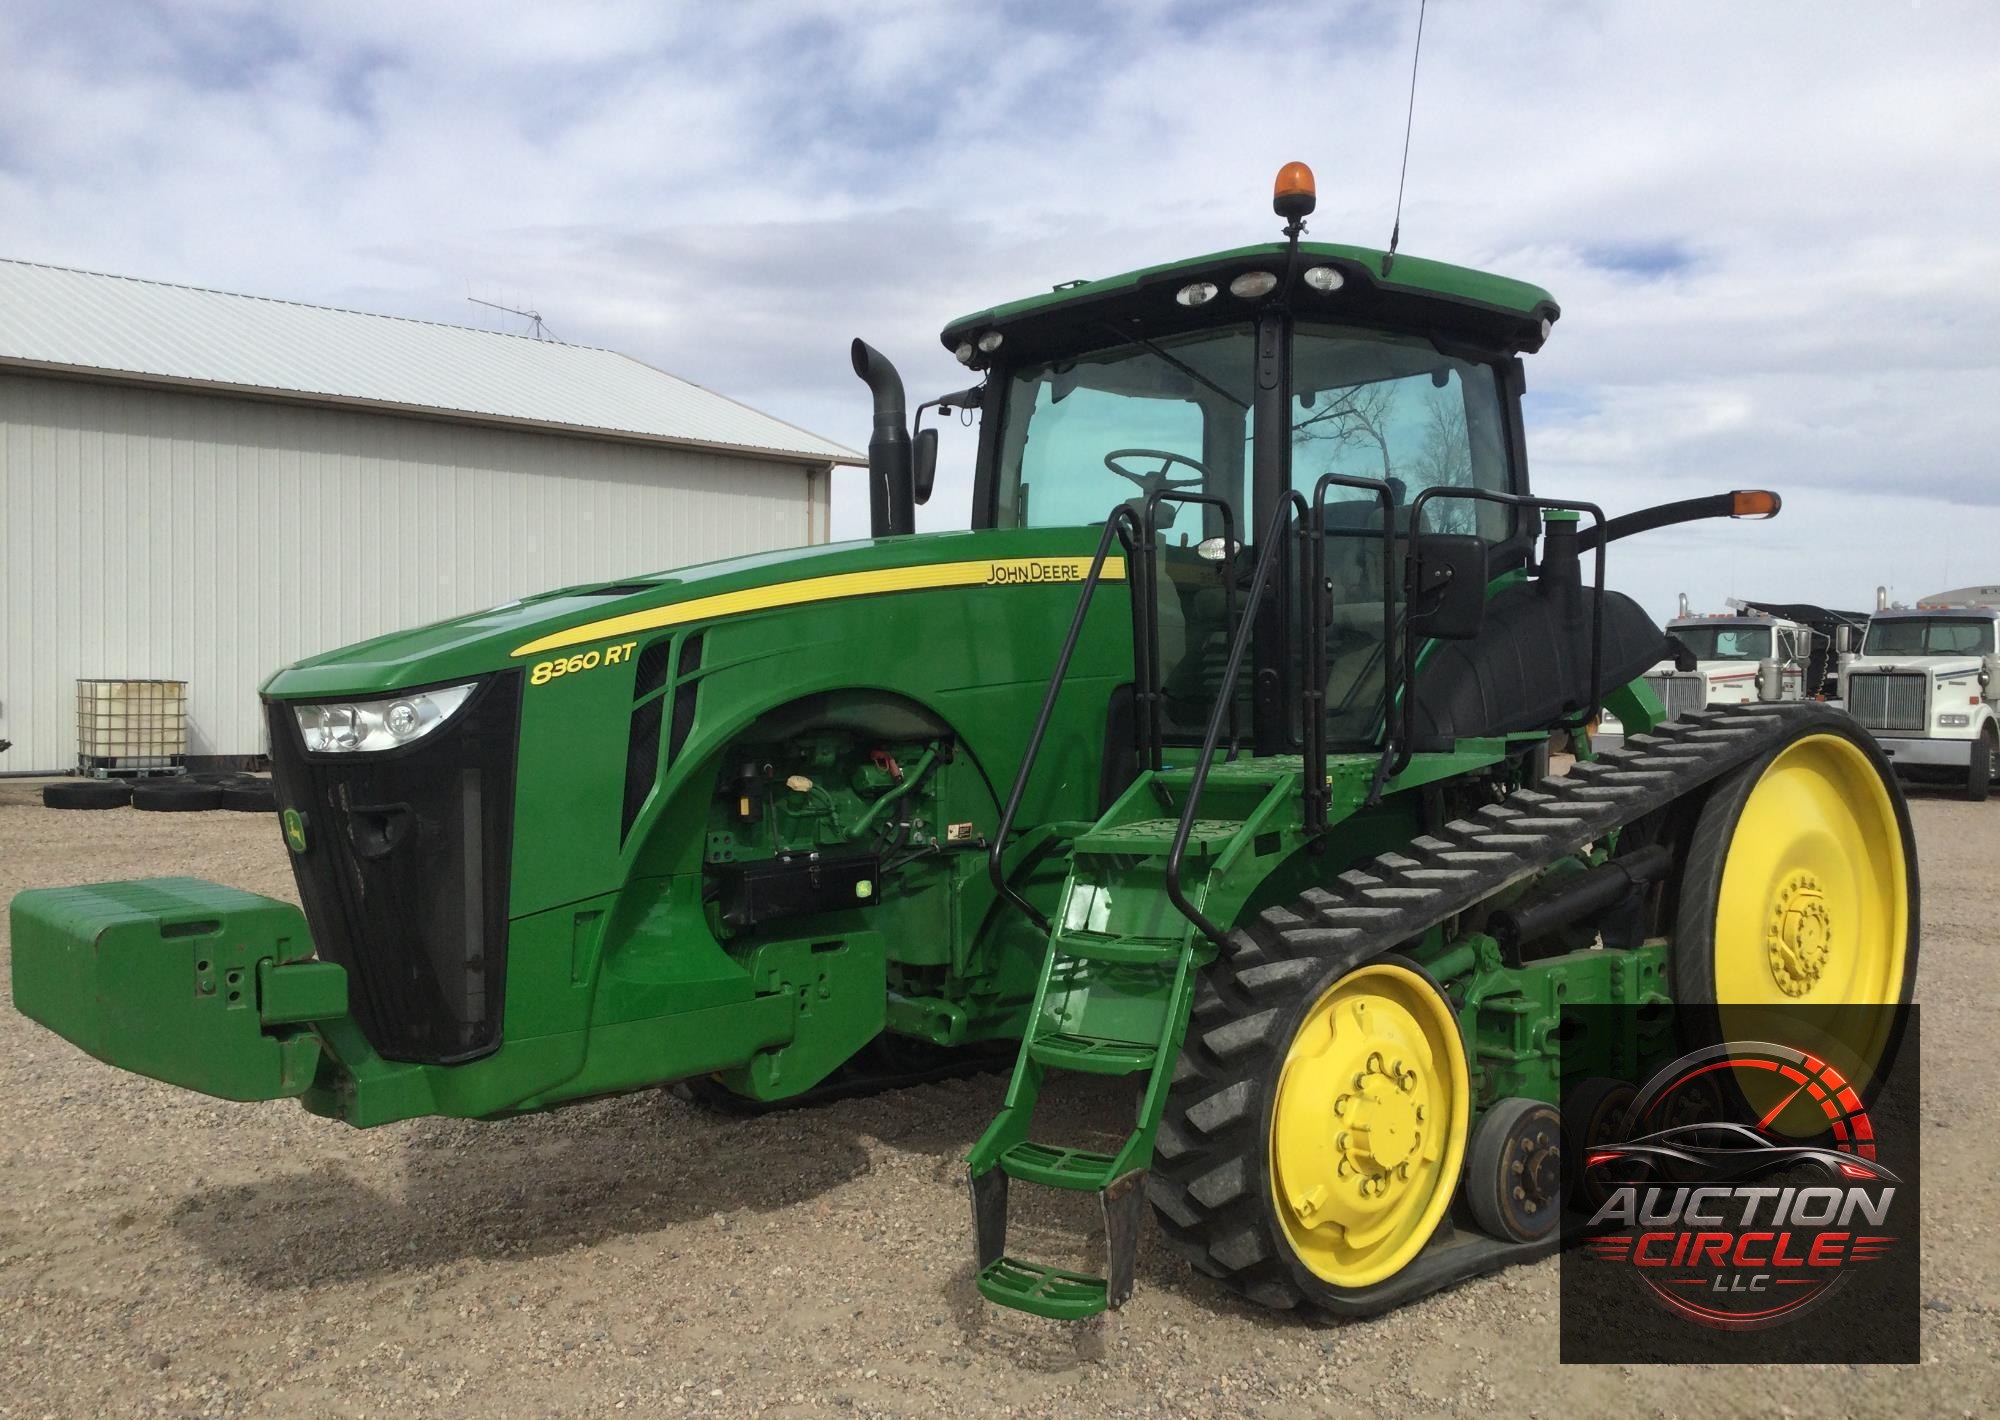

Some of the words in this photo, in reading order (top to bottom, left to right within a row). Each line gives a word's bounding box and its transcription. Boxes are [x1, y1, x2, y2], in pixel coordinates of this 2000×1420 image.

[987, 564, 1029, 582] JOHN
[1030, 563, 1080, 580] DEERE
[530, 651, 600, 685] 8360
[604, 642, 638, 666] RT
